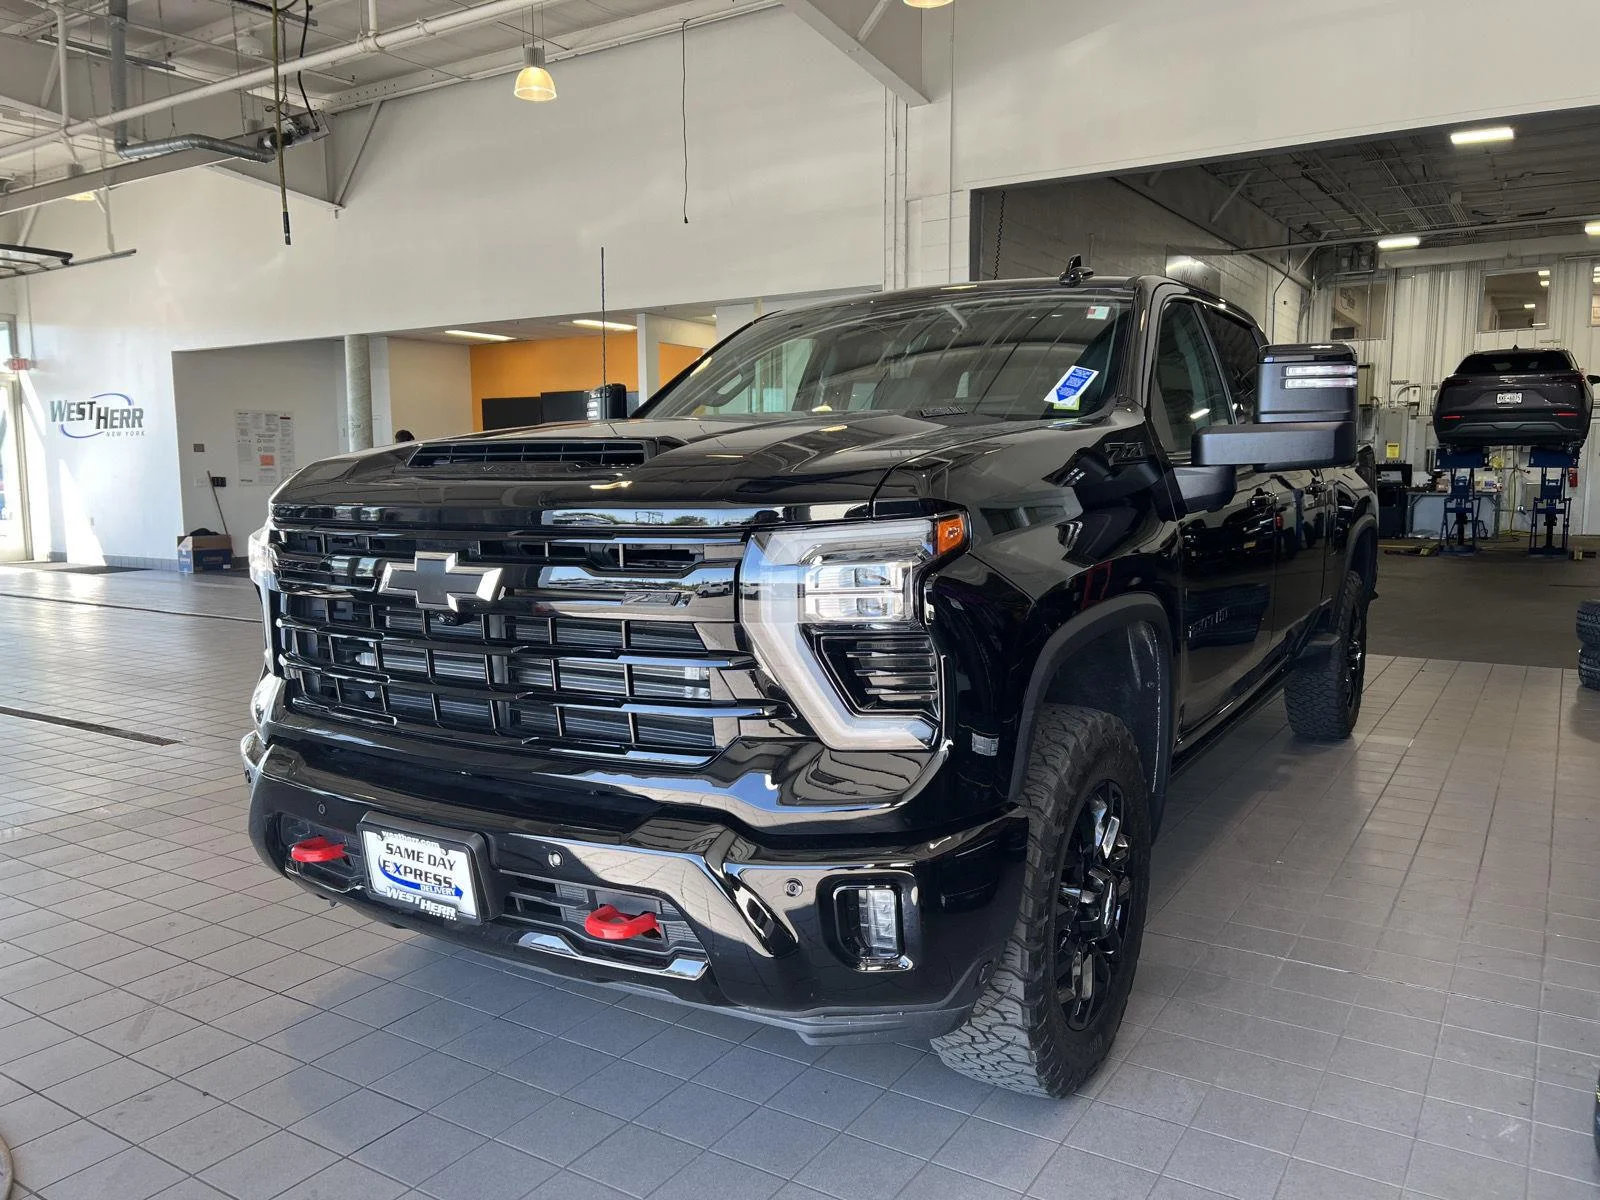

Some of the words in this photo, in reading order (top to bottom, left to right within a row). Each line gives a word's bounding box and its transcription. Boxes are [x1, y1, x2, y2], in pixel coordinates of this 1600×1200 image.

[50, 400, 96, 422] WEST
[95, 407, 144, 429] HERR
[385, 842, 424, 864] SAME
[427, 853, 457, 872] DAY
[382, 859, 453, 888] EXPRESS
[386, 885, 422, 905] WEST
[420, 899, 457, 917] HERR
[420, 884, 455, 897] DELIVERY
